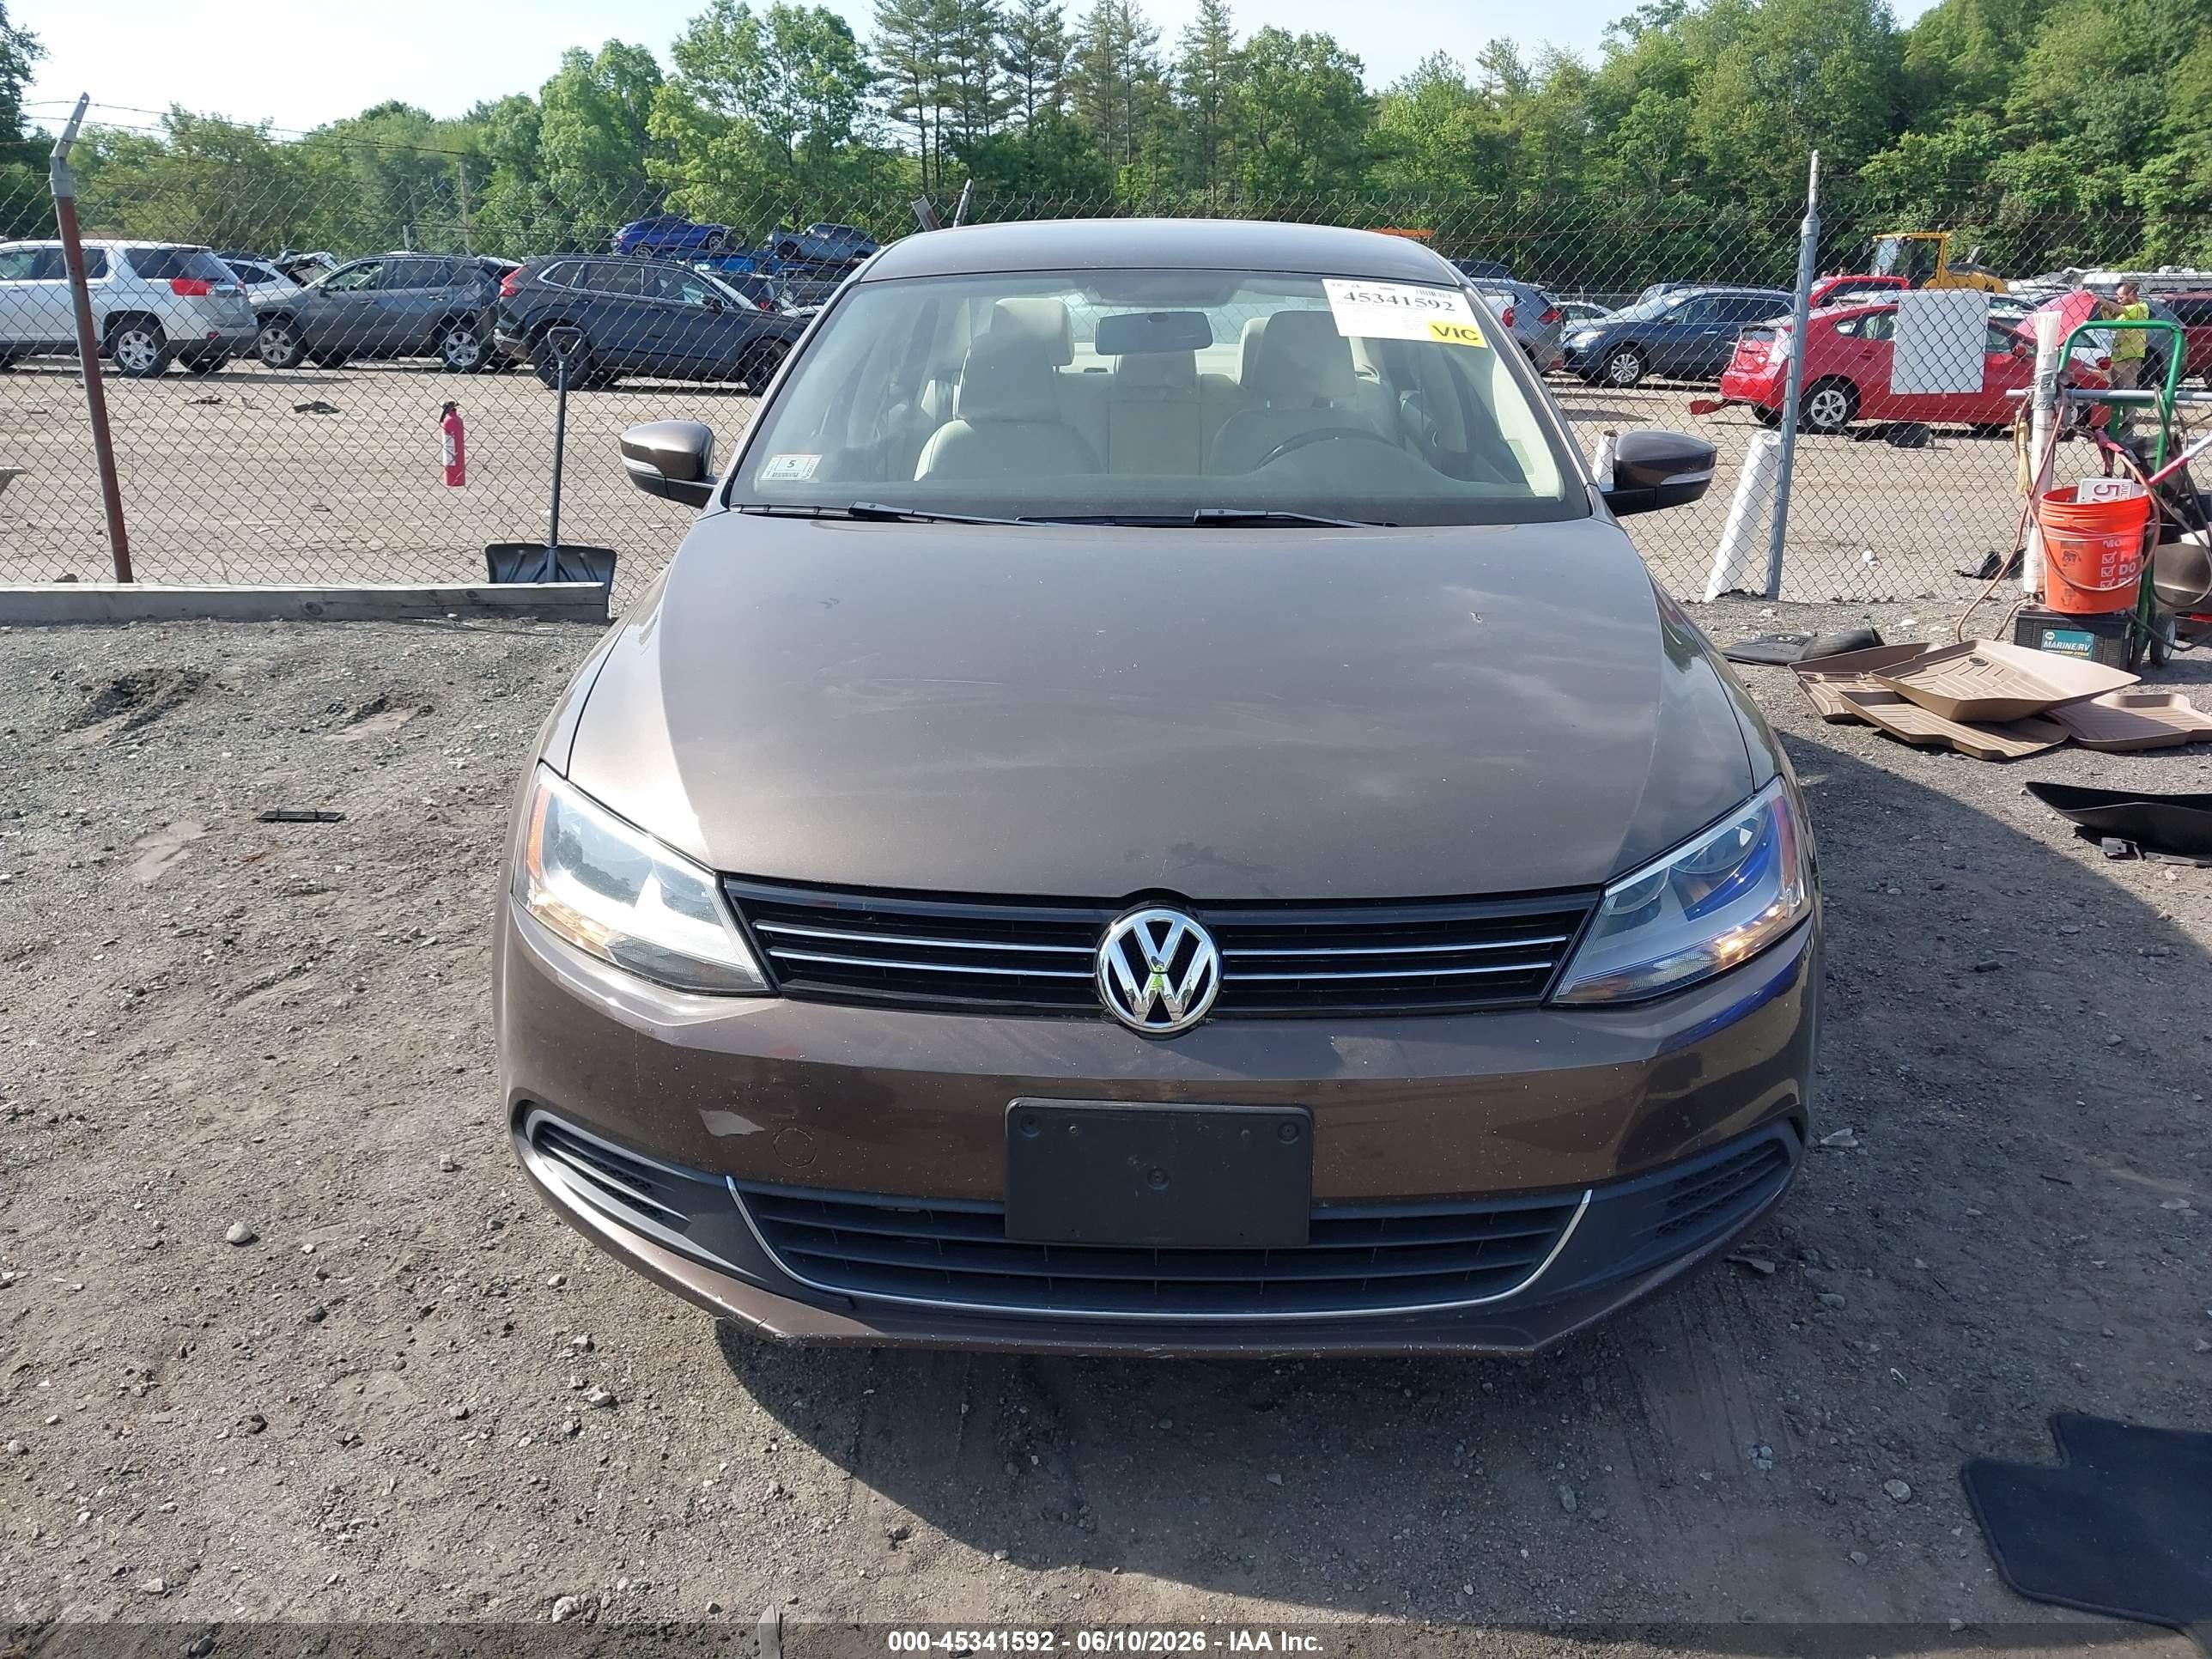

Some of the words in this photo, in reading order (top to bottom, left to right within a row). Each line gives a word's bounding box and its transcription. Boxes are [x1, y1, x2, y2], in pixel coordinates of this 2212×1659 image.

[1344, 291, 1456, 312] 45341592
[1431, 325, 1480, 341] VIC
[787, 459, 797, 468] 5
[2043, 641, 2091, 652] MARINE/RV
[1100, 911, 1215, 1031] VW
